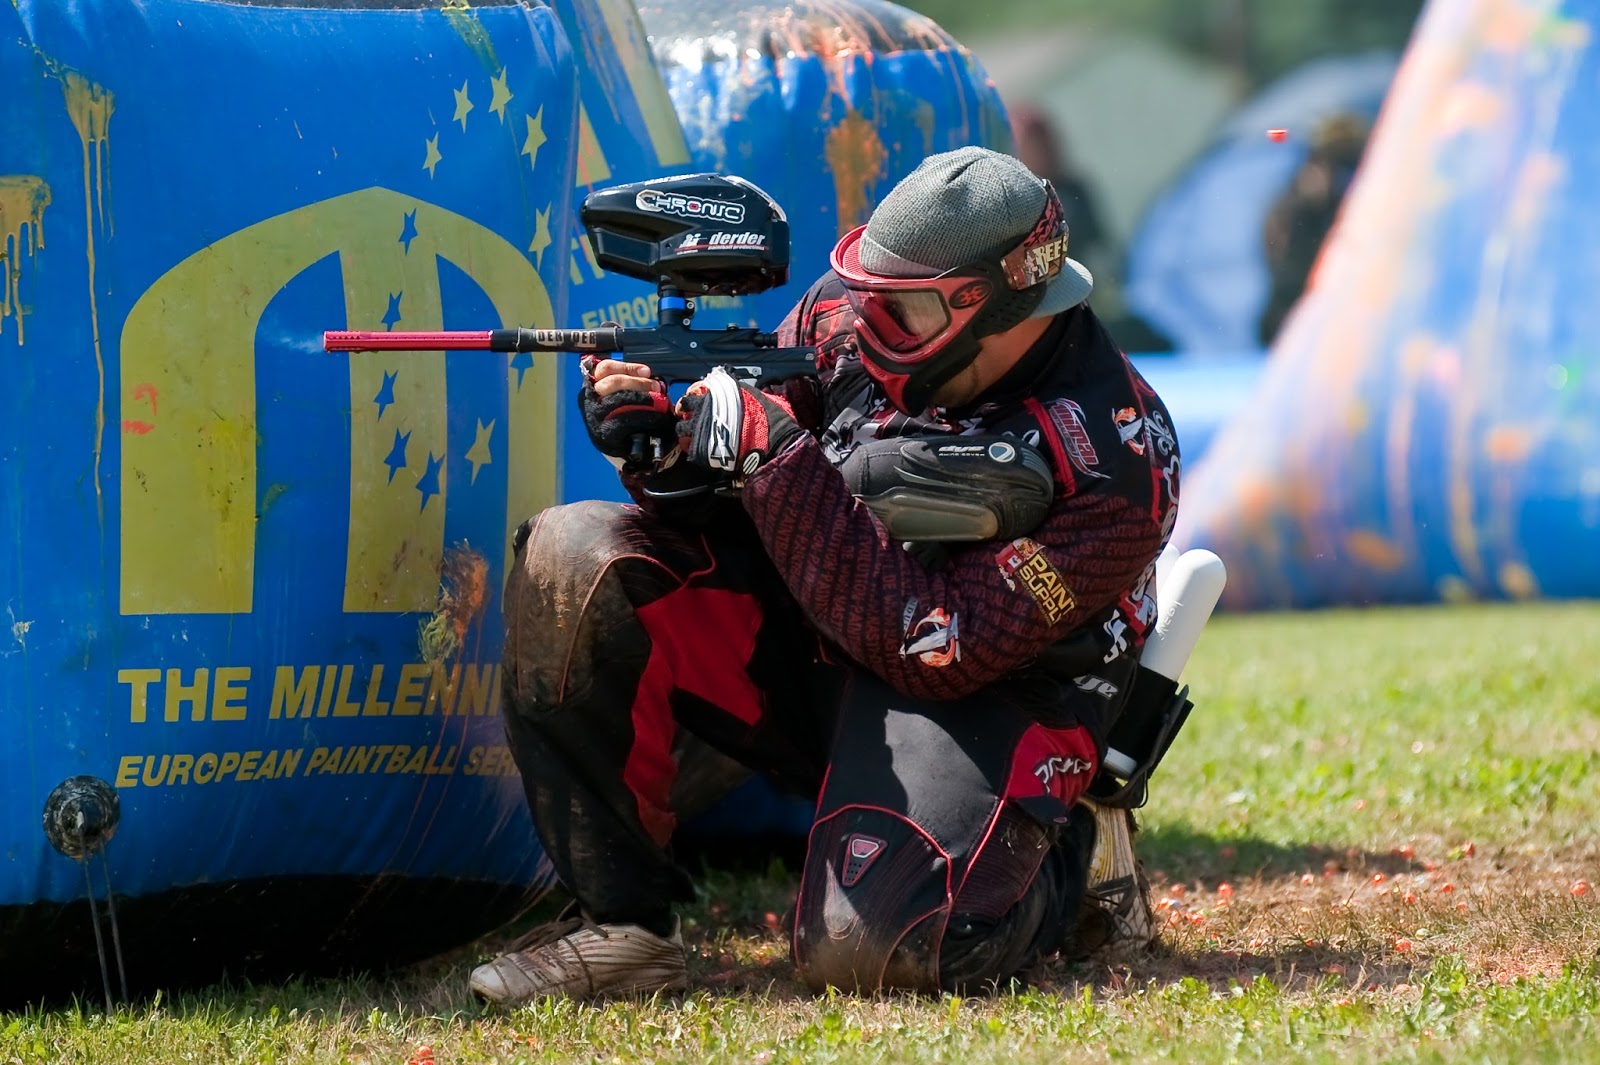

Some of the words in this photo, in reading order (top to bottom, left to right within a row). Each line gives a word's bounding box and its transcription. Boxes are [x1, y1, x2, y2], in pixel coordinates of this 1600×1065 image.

[635, 189, 746, 224] CHRONIC
[708, 231, 766, 246] derder
[1018, 565, 1062, 625] SUPPLY
[1028, 553, 1075, 616] PAINT
[117, 666, 252, 723] THE
[114, 748, 304, 788] EUROPEAN
[303, 744, 457, 777] PAINTBALL
